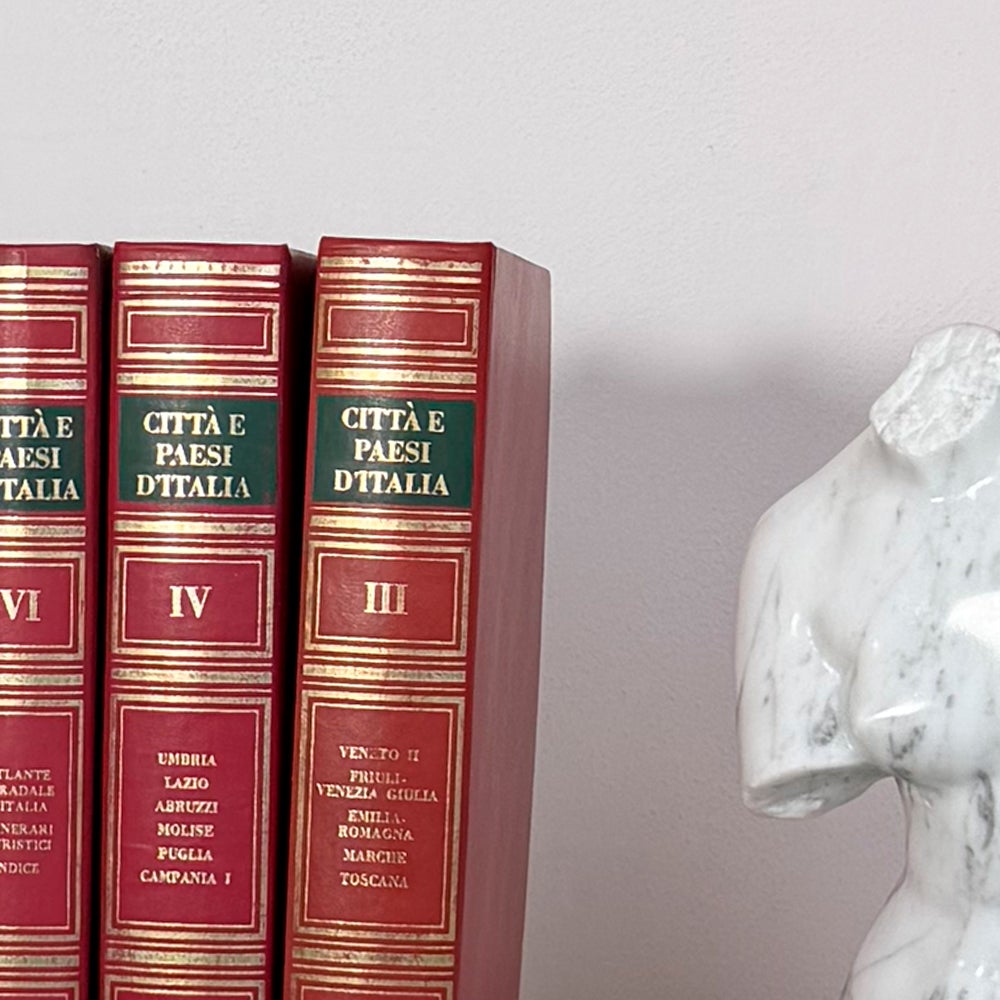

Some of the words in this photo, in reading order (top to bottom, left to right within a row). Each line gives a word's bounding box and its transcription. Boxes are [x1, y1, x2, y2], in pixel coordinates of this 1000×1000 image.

[56, 416, 74, 438] E
[143, 405, 220, 436] CITTÀ
[230, 414, 245, 436] E
[341, 402, 419, 432] CITTÀ
[428, 411, 445, 433] E
[0, 447, 61, 469] AESI
[155, 445, 233, 467] PAESI
[354, 440, 431, 464] PAESI
[137, 475, 250, 498] D'ITALIA
[334, 469, 449, 496] D'ITALIA
[0, 589, 41, 621] VI
[170, 585, 212, 618] IV
[363, 581, 408, 615] III
[158, 753, 217, 766] UMBRIA
[339, 746, 399, 760] VENETO
[164, 776, 209, 789] LAZIO
[316, 783, 377, 799] VENEZIA
[386, 788, 438, 802] GIULIA
[155, 800, 218, 813] ABRUZZI
[157, 823, 214, 837] MOLISE
[338, 825, 414, 841] ROMAGNA
[158, 847, 213, 861] PUGLIA
[343, 848, 407, 864] MARCHE
[140, 870, 216, 884] CAMPANIA
[225, 873, 231, 885] I
[339, 872, 408, 888] TOSCANA
